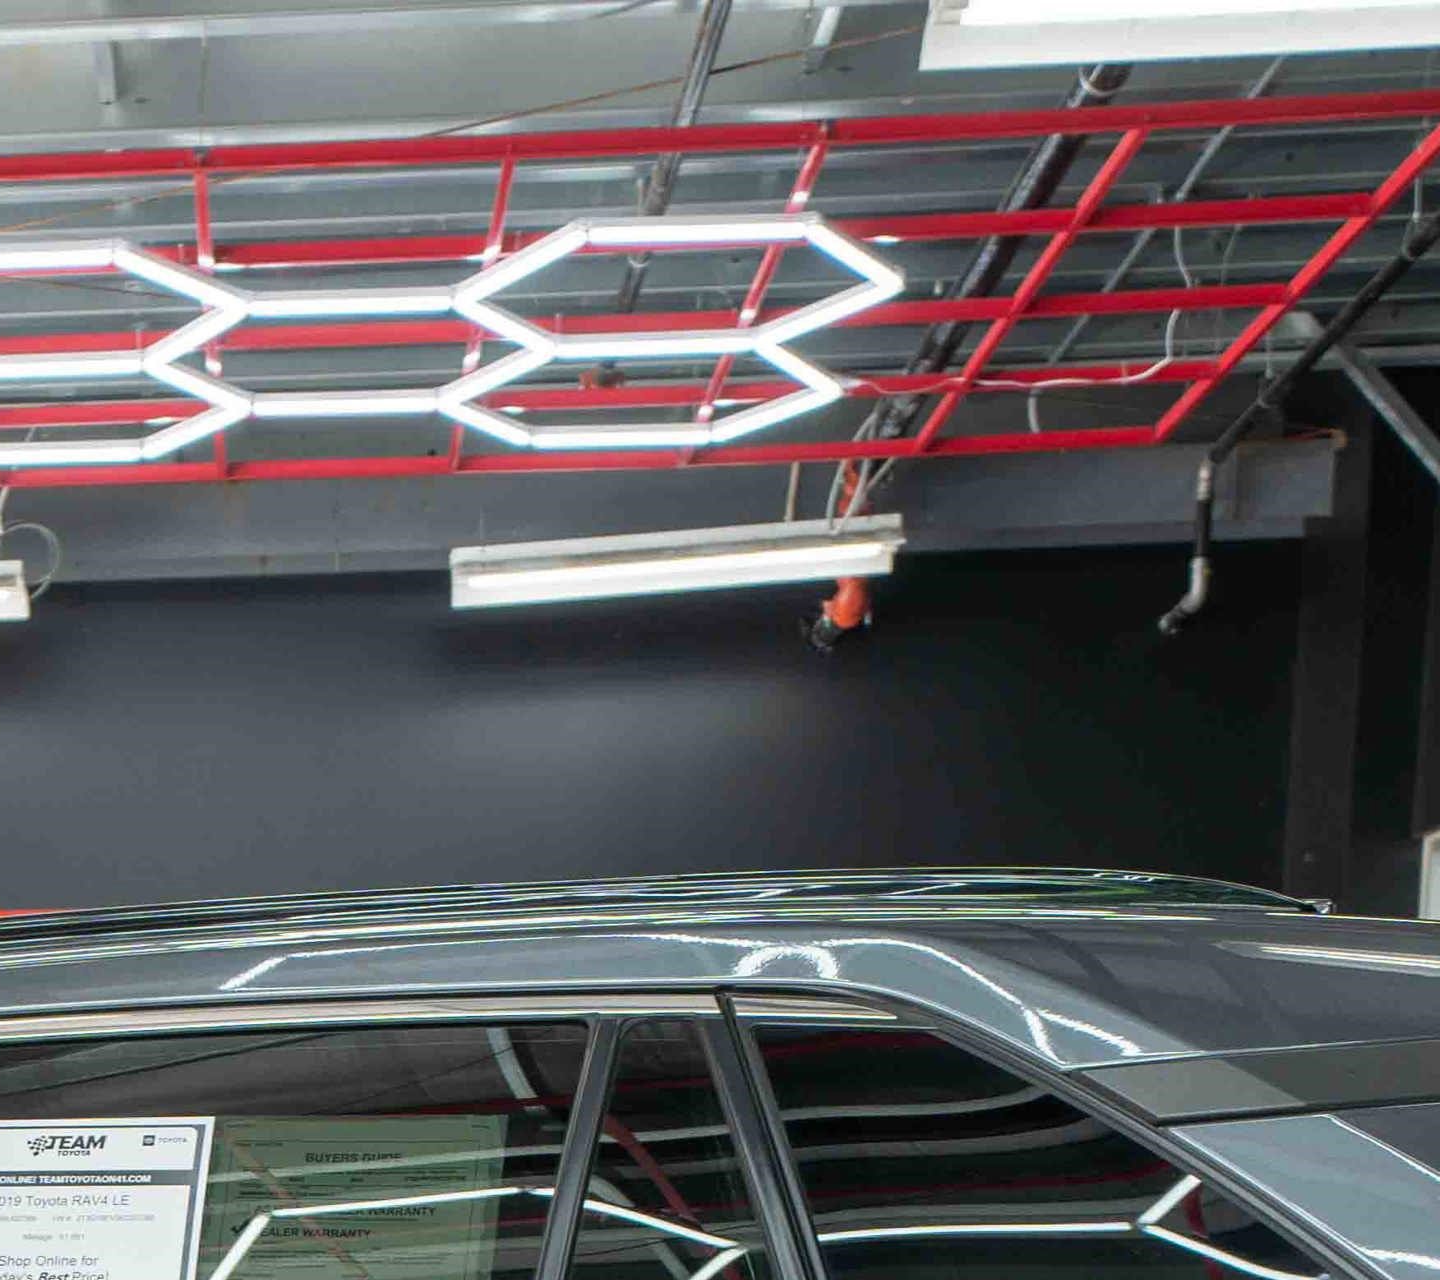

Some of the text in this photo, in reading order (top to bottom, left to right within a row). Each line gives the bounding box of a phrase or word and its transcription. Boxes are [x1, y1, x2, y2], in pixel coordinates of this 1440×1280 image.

[46, 1135, 107, 1149] TEAM
[305, 1152, 359, 1163] BUYERS
[0, 1175, 37, 1184] ONLINE!
[39, 1174, 152, 1184] TEAMTOYOTAON41.COM
[27, 1196, 69, 1208] Toyota
[72, 1195, 108, 1206] RAV4
[112, 1195, 130, 1206] LE
[259, 1227, 371, 1238] EALER WARRANTY
[35, 1255, 77, 1266] Online
[81, 1255, 99, 1266] for
